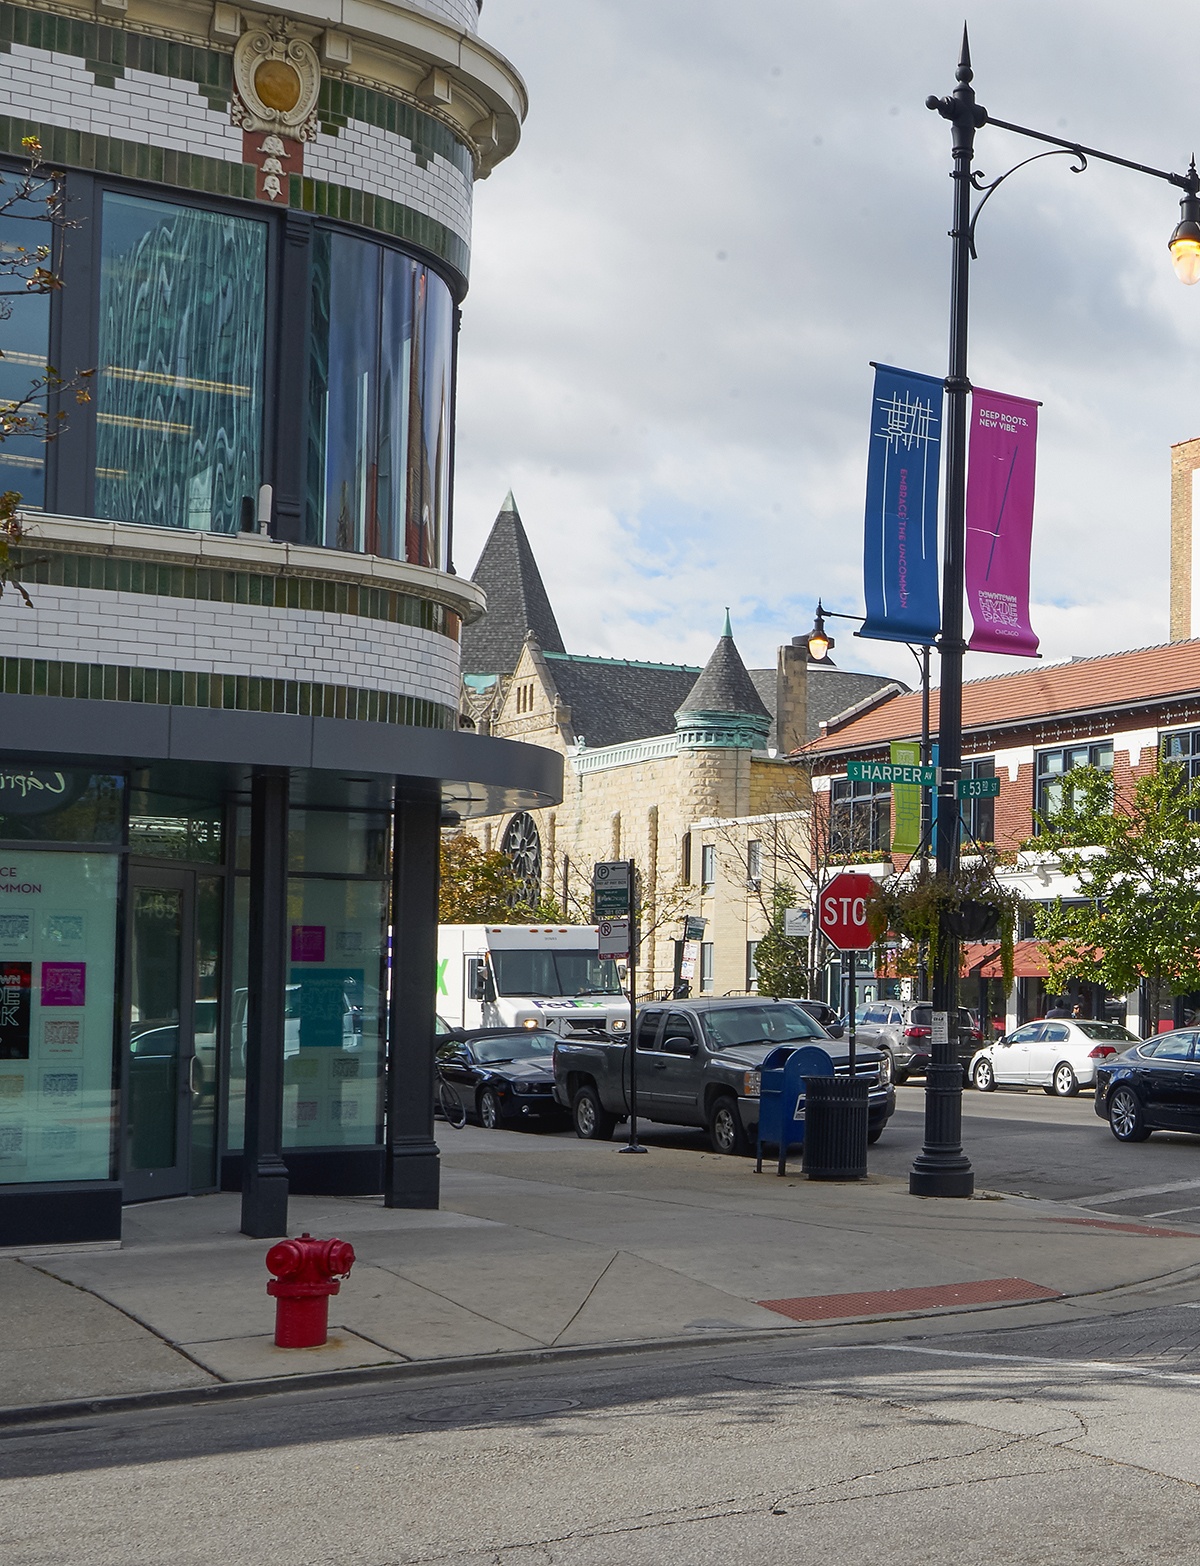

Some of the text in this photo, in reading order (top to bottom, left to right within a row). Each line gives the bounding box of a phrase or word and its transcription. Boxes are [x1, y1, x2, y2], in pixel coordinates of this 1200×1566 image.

[979, 408, 1029, 427] DEEP ROOTS.
[979, 418, 1018, 434] NEW VIBE.
[897, 468, 908, 609] EMBRACE THE UNCOMMON
[978, 590, 1018, 603] DOWNTOWN
[979, 597, 1018, 618] HYDE
[981, 610, 1022, 629] PARK
[994, 628, 1019, 637] CHICAGO
[853, 764, 933, 783] S HARPER AV
[962, 785, 967, 794] E
[991, 783, 997, 792] ST
[823, 896, 867, 926] STO
[531, 999, 605, 1010] FedEx
